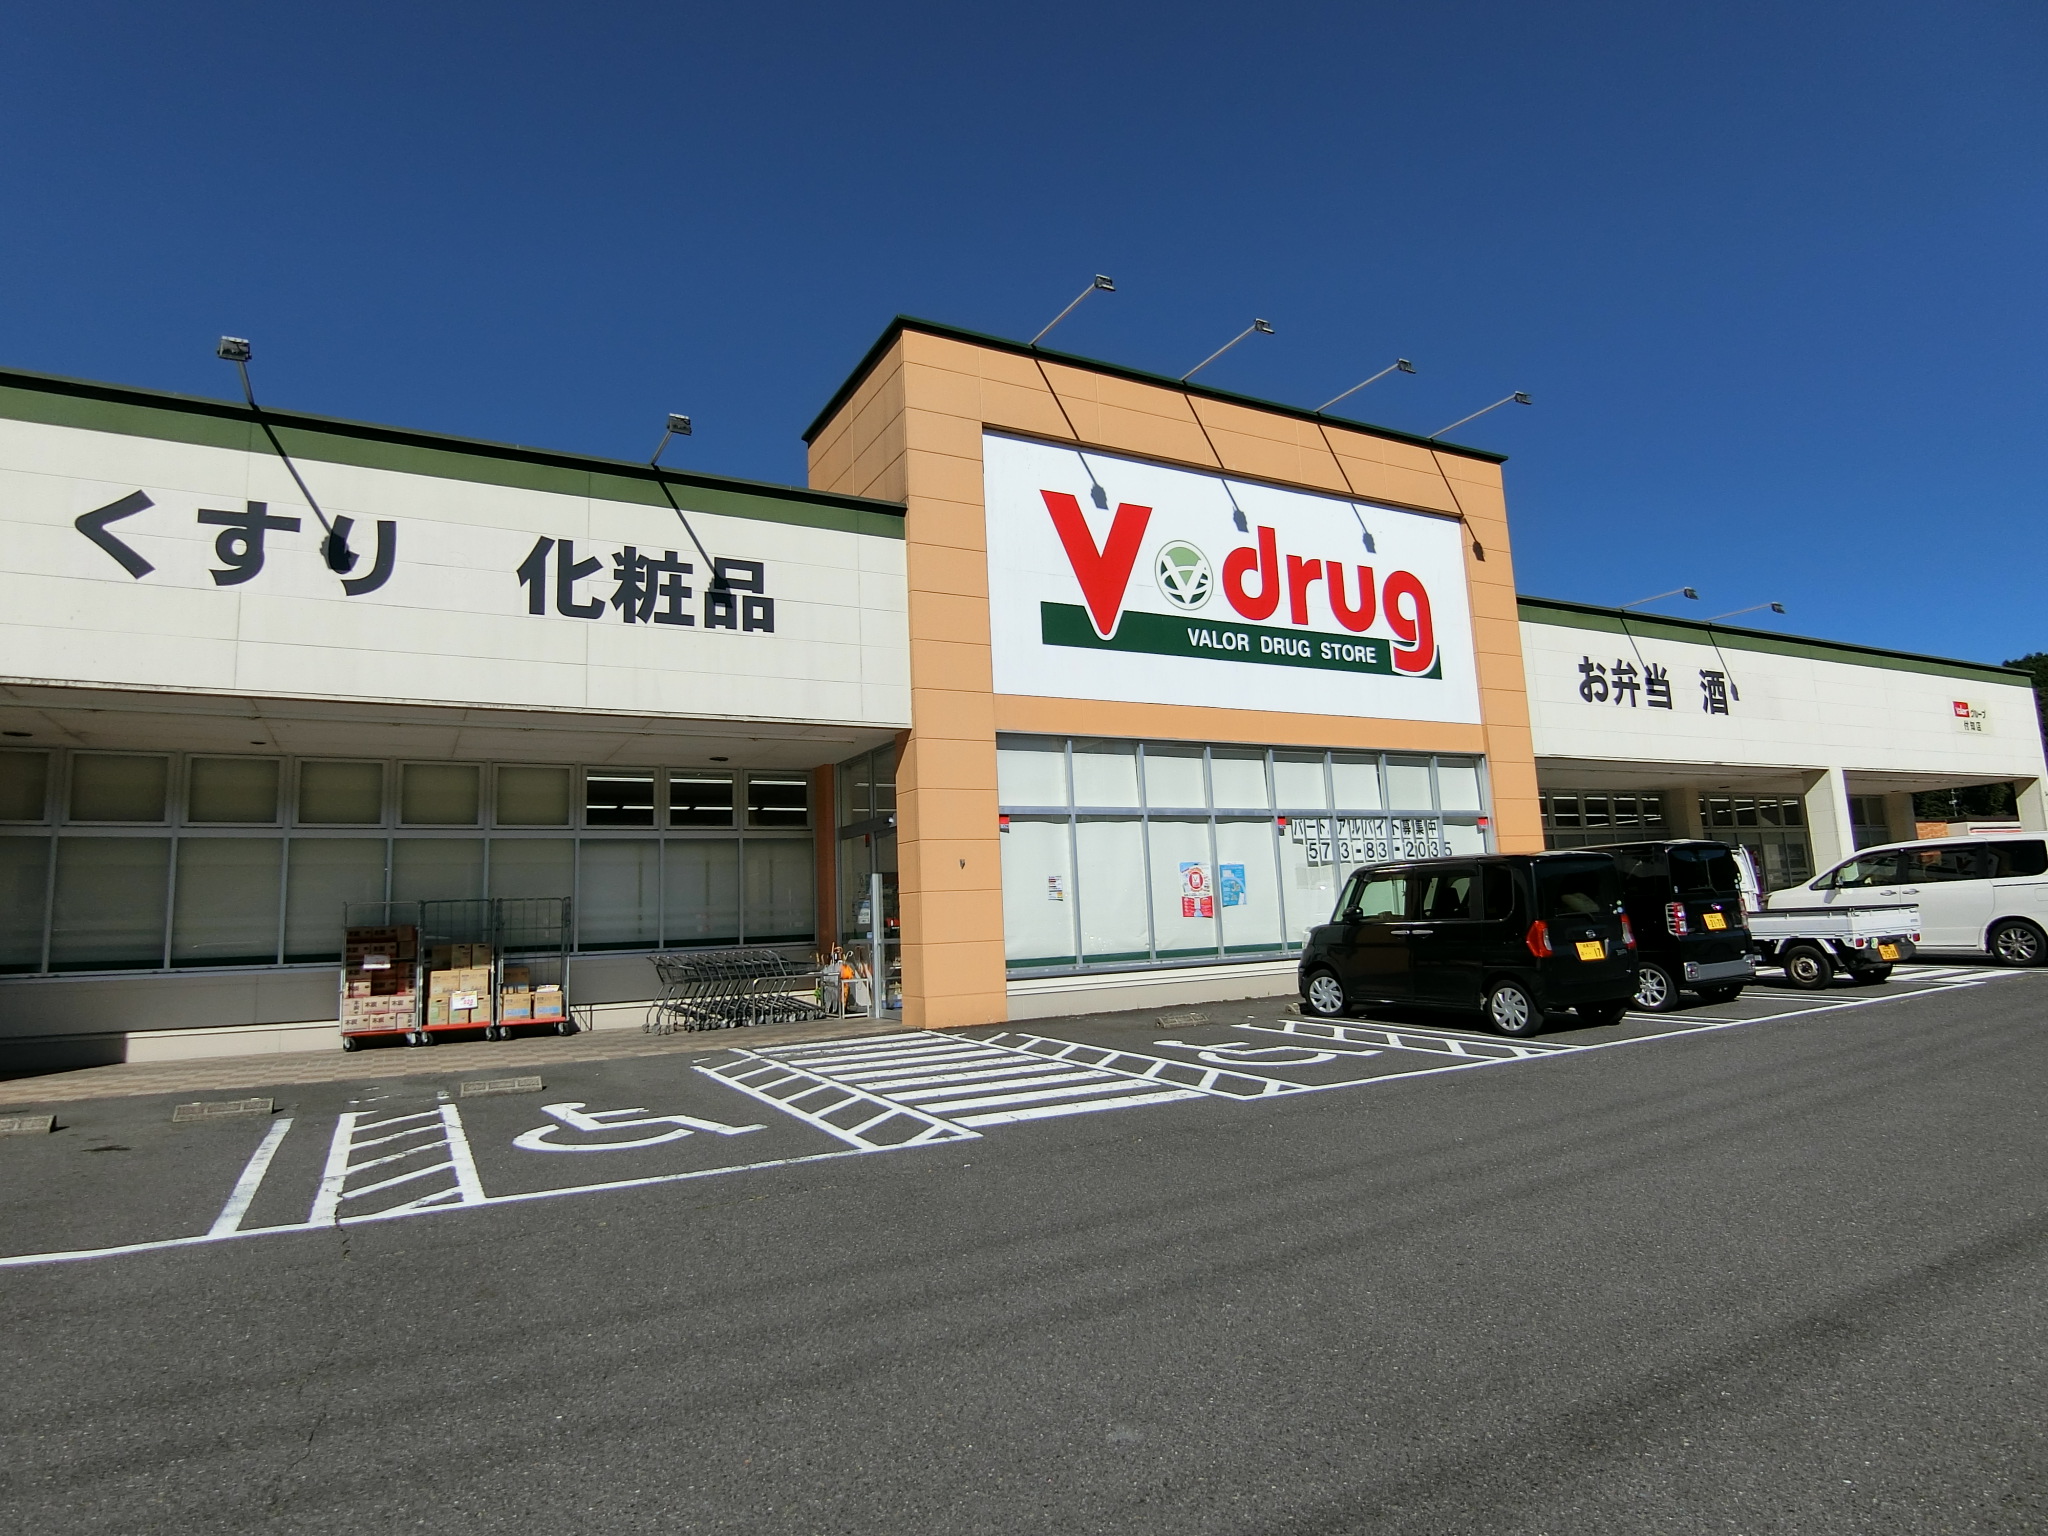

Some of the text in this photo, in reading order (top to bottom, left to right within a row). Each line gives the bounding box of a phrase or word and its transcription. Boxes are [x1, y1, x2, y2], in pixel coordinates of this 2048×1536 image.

[74, 490, 775, 633] くすり 化粧品
[1040, 490, 1435, 672] V drug
[1187, 628, 1377, 664] VALOR DRUG STORE
[1578, 656, 1729, 715] お弁当 酒
